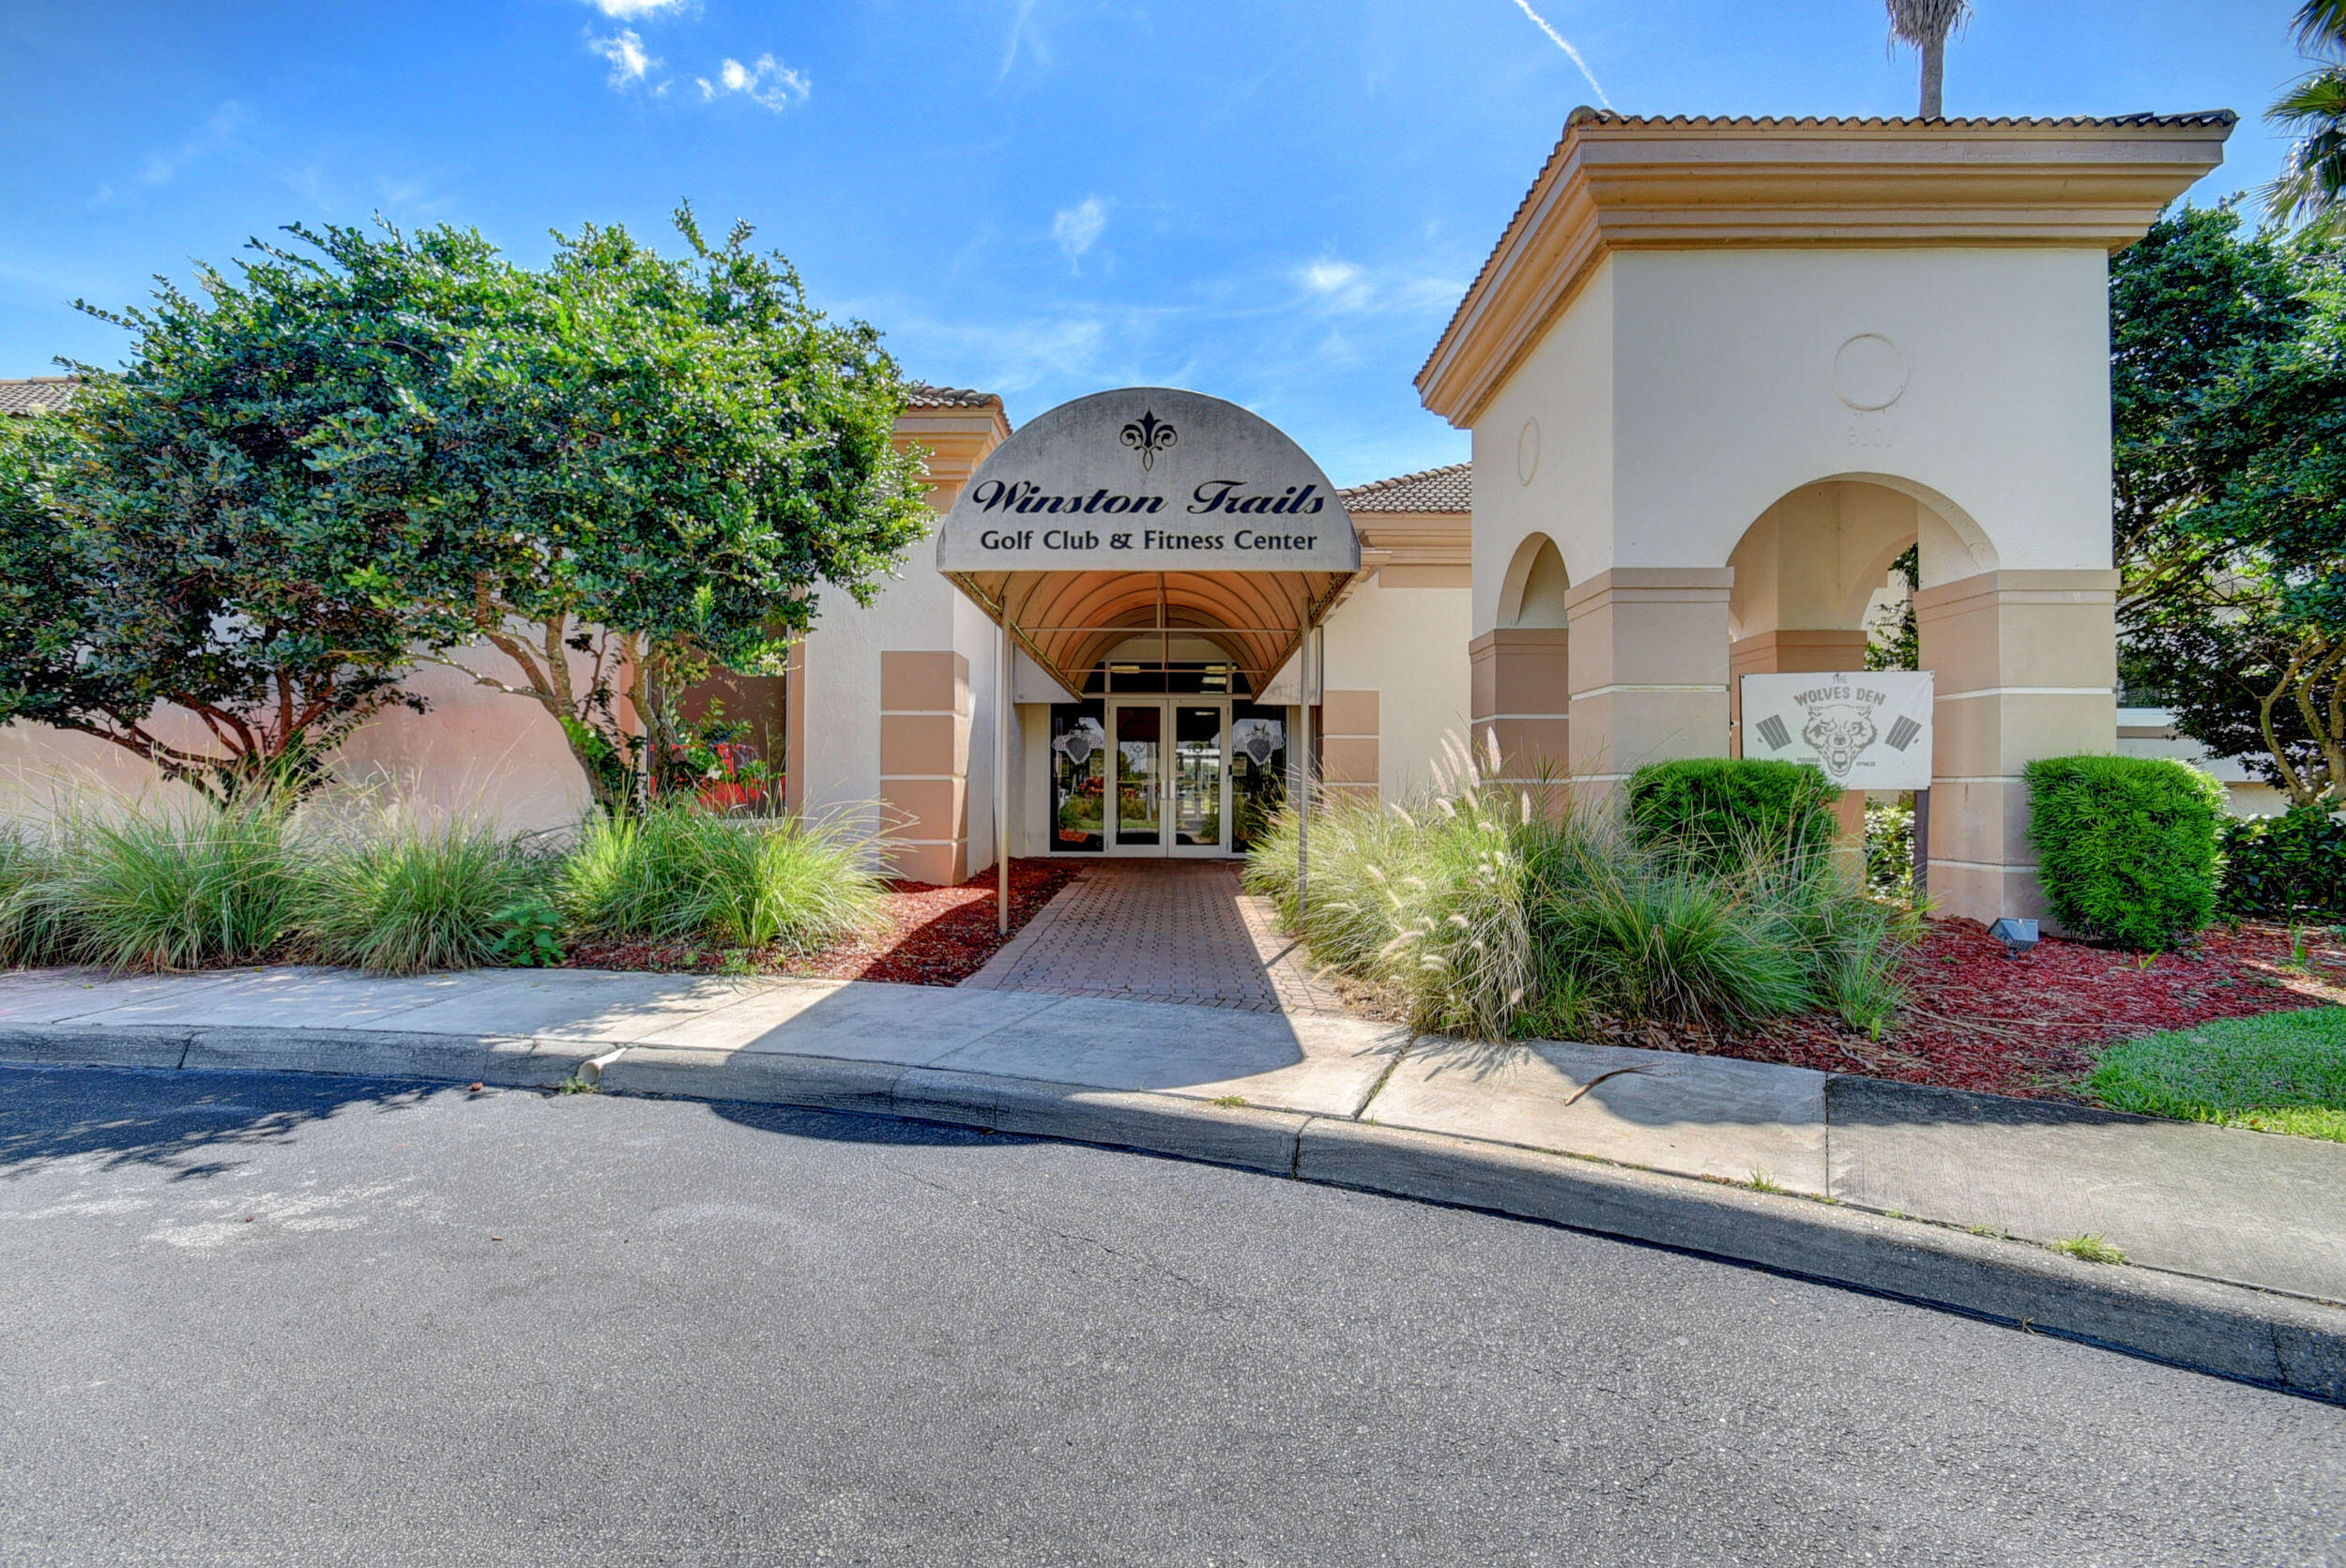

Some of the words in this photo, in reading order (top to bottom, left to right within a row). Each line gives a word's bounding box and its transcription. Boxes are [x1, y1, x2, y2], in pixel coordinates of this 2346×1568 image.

[972, 480, 1168, 514] Winston
[1187, 480, 1324, 514] Trails
[981, 530, 1033, 550] Golf
[1044, 530, 1100, 550] Club
[1109, 533, 1133, 550] &
[1144, 530, 1224, 550] Fitness
[1234, 530, 1318, 550] Center
[1793, 686, 1851, 707] WOLVES
[1855, 688, 1886, 706] DEN
